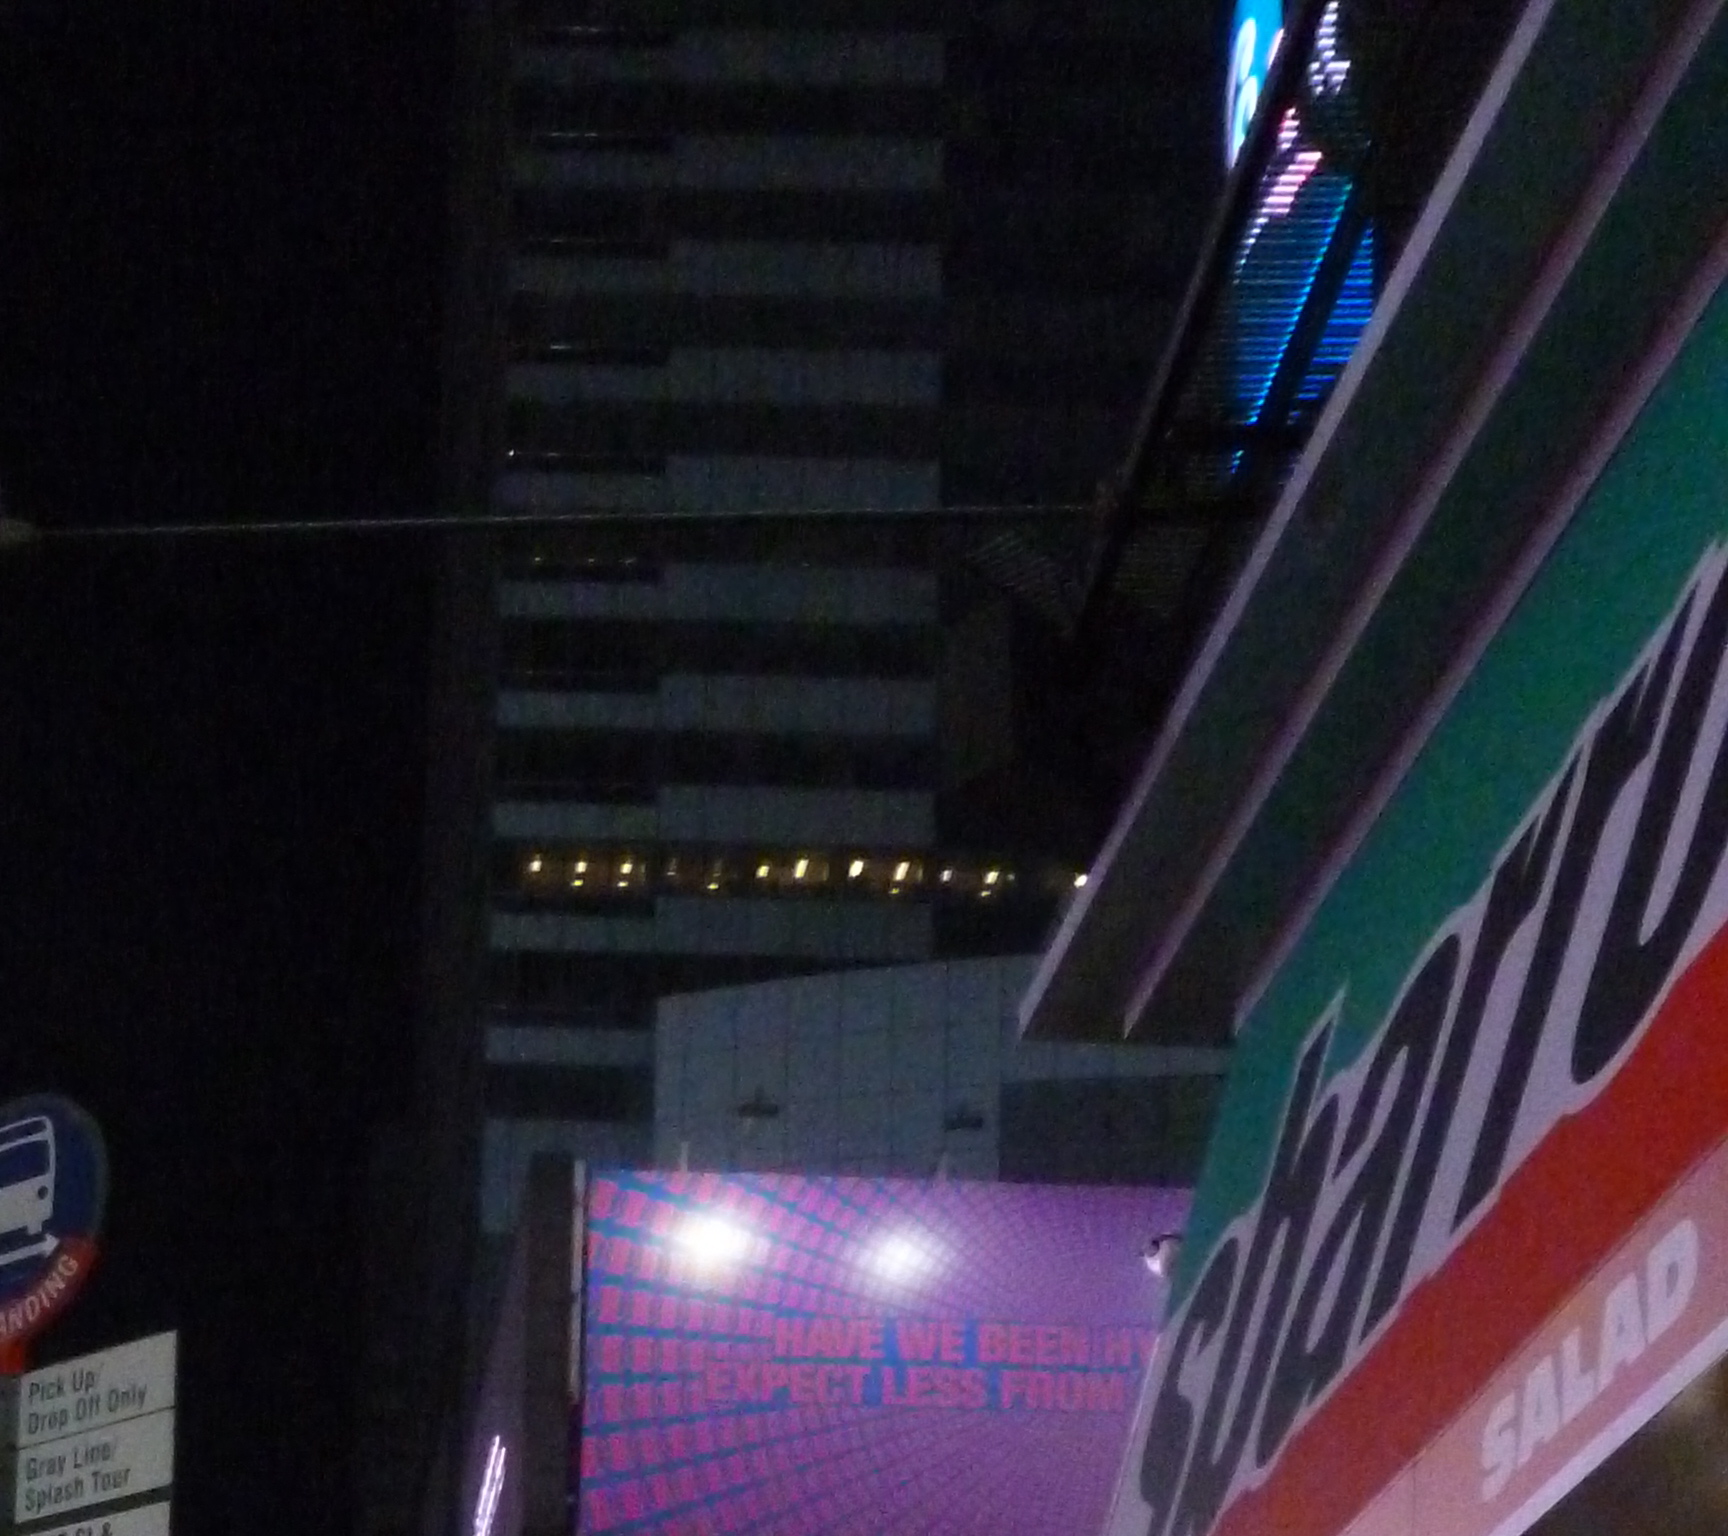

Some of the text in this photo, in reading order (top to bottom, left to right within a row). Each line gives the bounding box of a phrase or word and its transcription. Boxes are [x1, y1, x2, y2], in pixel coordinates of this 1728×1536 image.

[1479, 1218, 1700, 1502] SALAD
[28, 1381, 64, 1406] Pick
[28, 1410, 70, 1436] Drop
[108, 1383, 148, 1414] Only
[25, 1466, 131, 1515] Splash Tour
